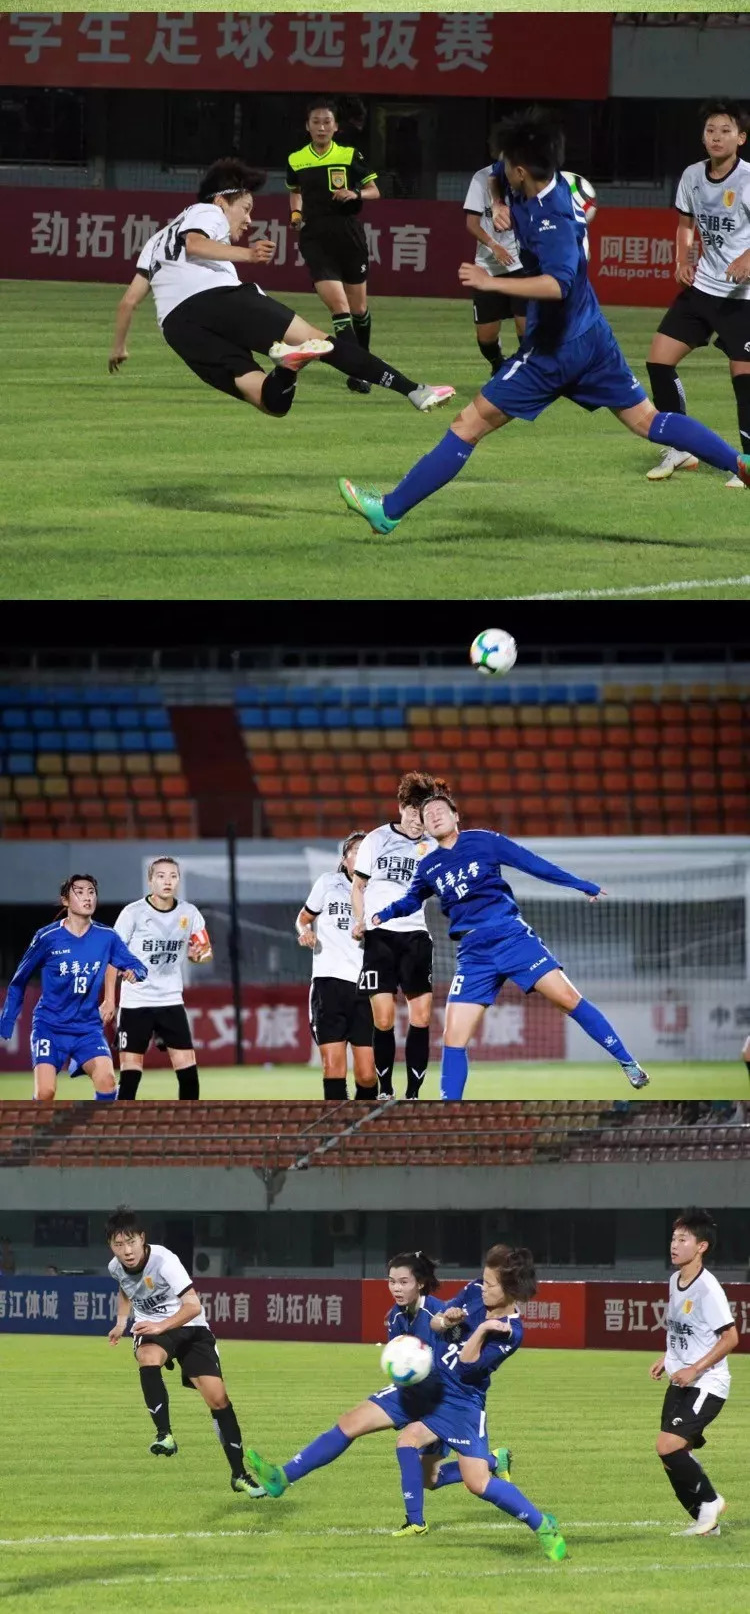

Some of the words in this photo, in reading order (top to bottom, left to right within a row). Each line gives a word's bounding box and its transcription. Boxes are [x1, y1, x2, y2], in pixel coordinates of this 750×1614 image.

[7, 12, 498, 73] 学生足球选拔赛
[598, 265, 671, 281] Alisports
[73, 976, 87, 994] 13
[35, 1038, 51, 1057] 13
[118, 1031, 128, 1049] 16
[266, 1292, 343, 1326] 劲拓体育
[604, 1298, 670, 1333] 晋江文
[447, 1437, 471, 1446] KELME
